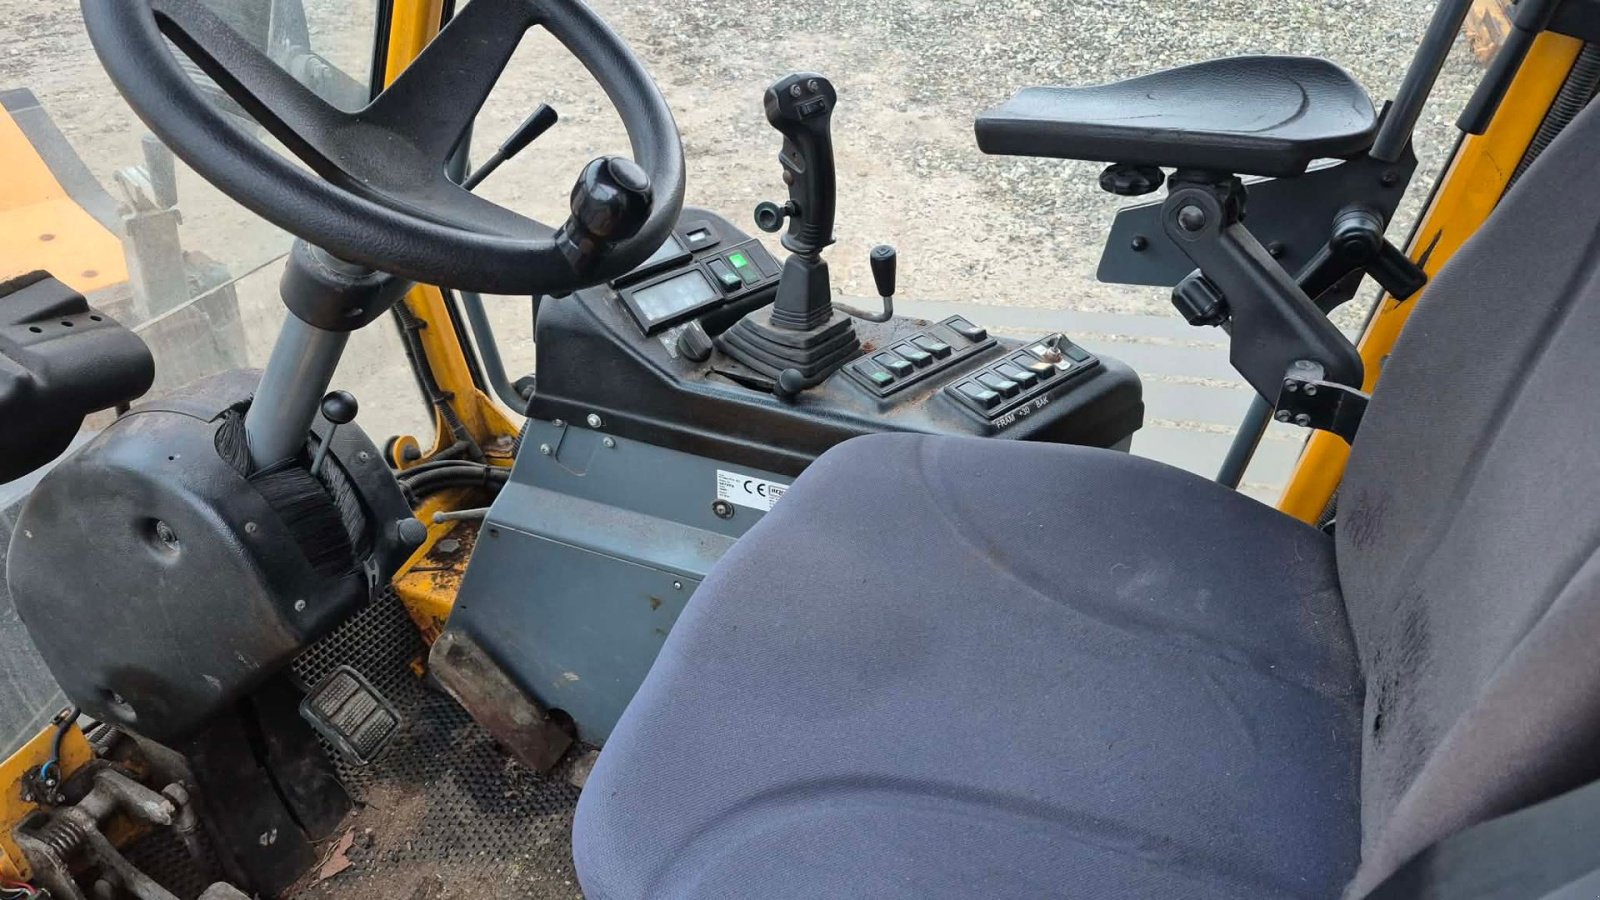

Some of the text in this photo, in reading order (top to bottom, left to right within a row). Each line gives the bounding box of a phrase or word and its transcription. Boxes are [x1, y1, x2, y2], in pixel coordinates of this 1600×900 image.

[996, 413, 1016, 428] FRAM
[1035, 395, 1049, 408] BAK
[743, 480, 766, 497] CE
